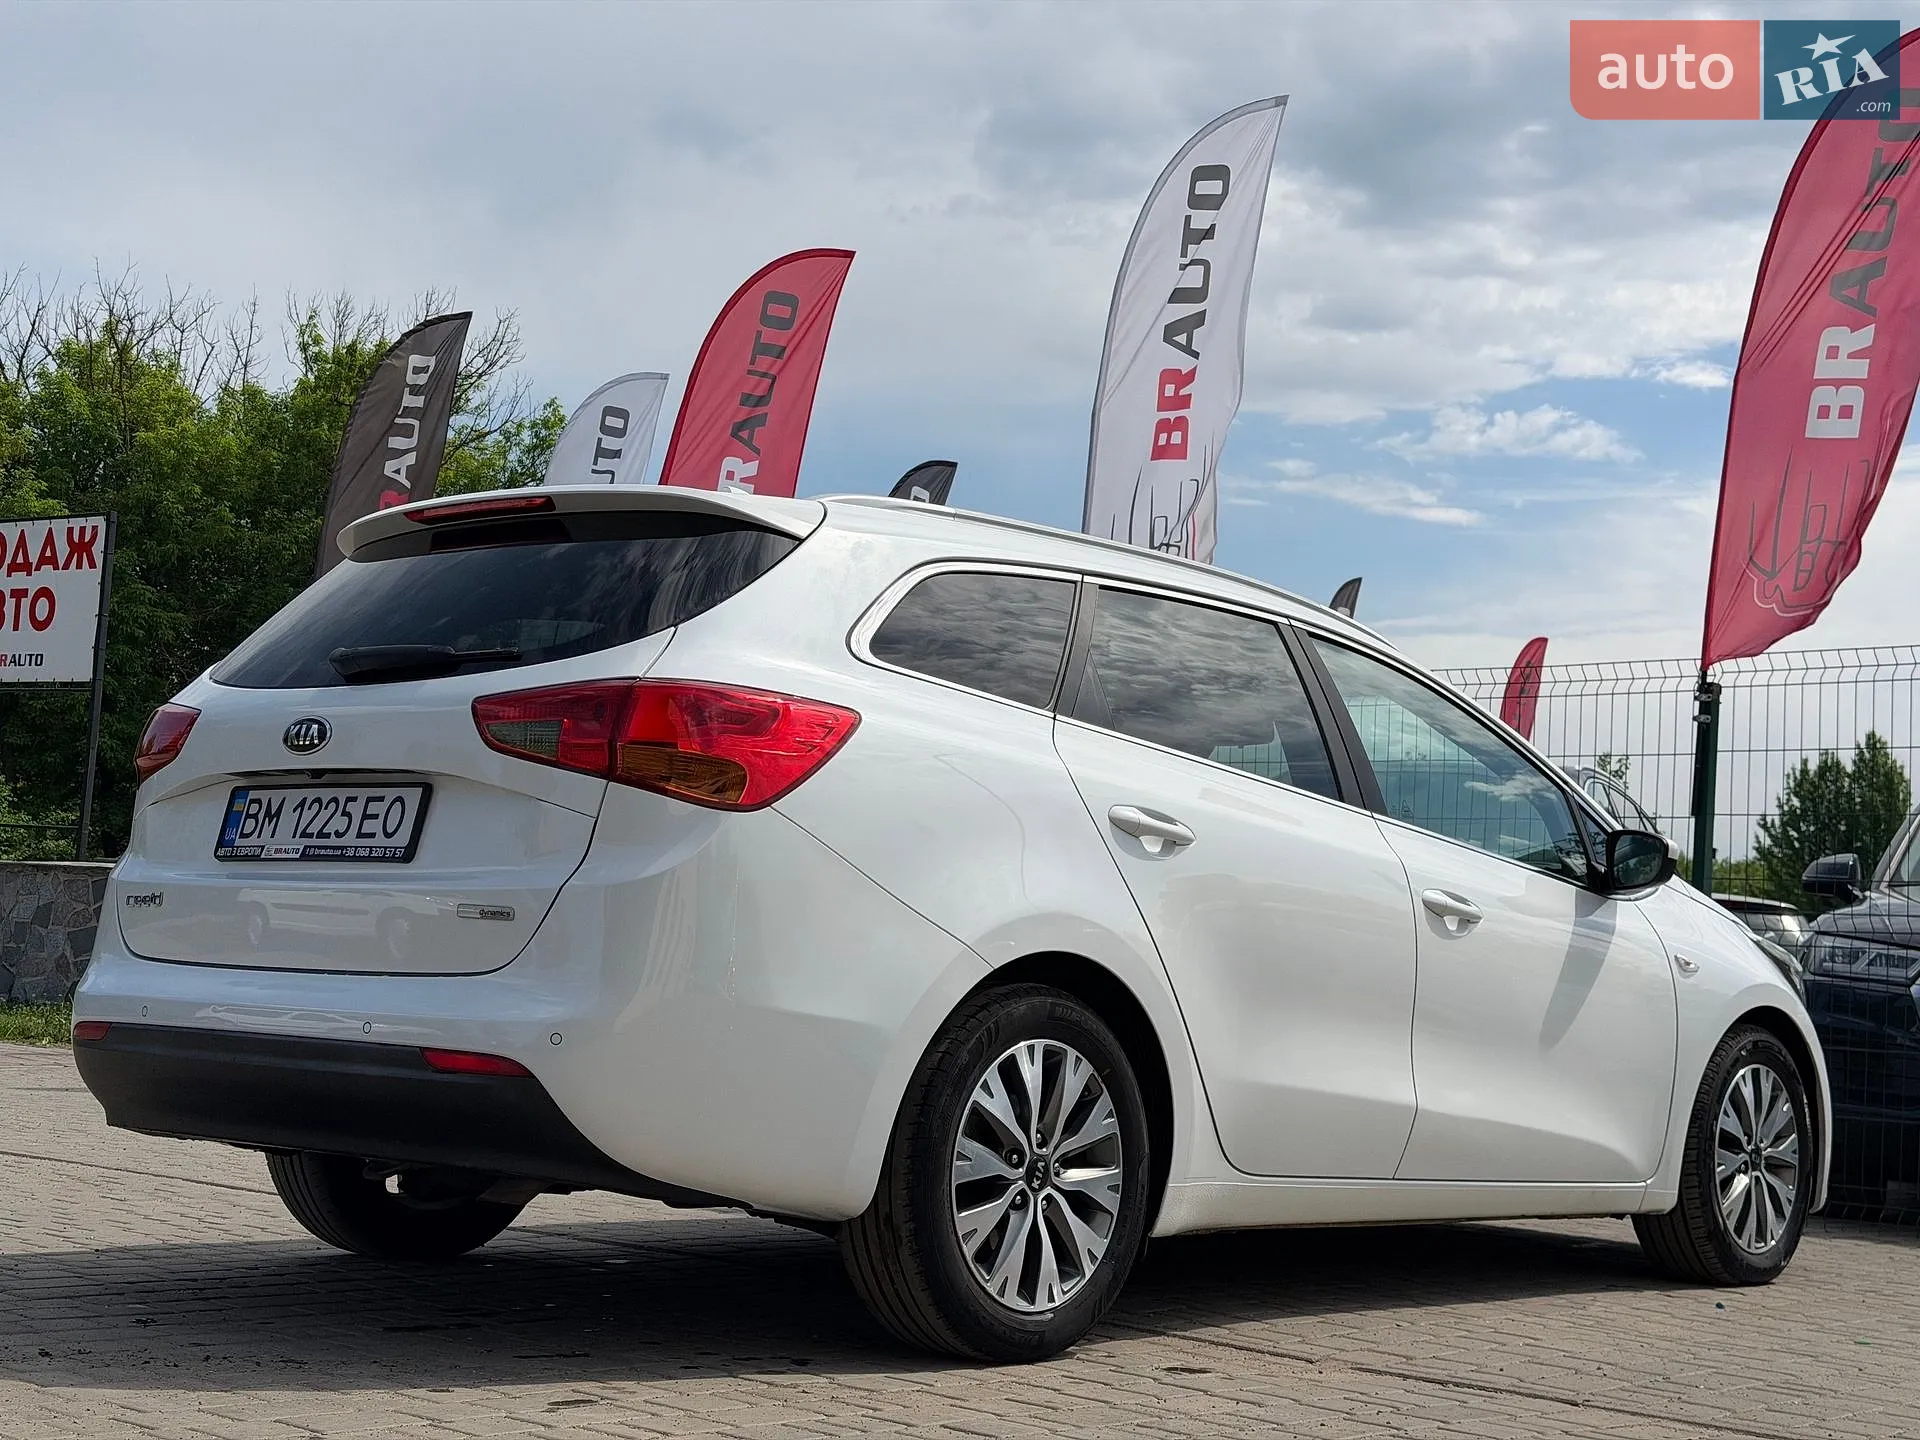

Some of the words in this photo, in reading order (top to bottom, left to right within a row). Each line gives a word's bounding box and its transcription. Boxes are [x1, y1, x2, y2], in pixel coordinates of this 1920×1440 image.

[1150, 164, 1231, 461] BRAUTO
[0, 525, 98, 577] ДАЖ
[0, 586, 56, 632] ТО
[287, 724, 319, 746] KIA
[224, 827, 236, 840] UA
[238, 796, 286, 839] BM
[291, 795, 359, 840] 1225
[355, 795, 406, 839] EO
[273, 847, 300, 856] BRAUTO
[342, 847, 355, 857] +38
[370, 848, 384, 857] 320
[384, 848, 394, 858] 57
[394, 848, 405, 858] 57
